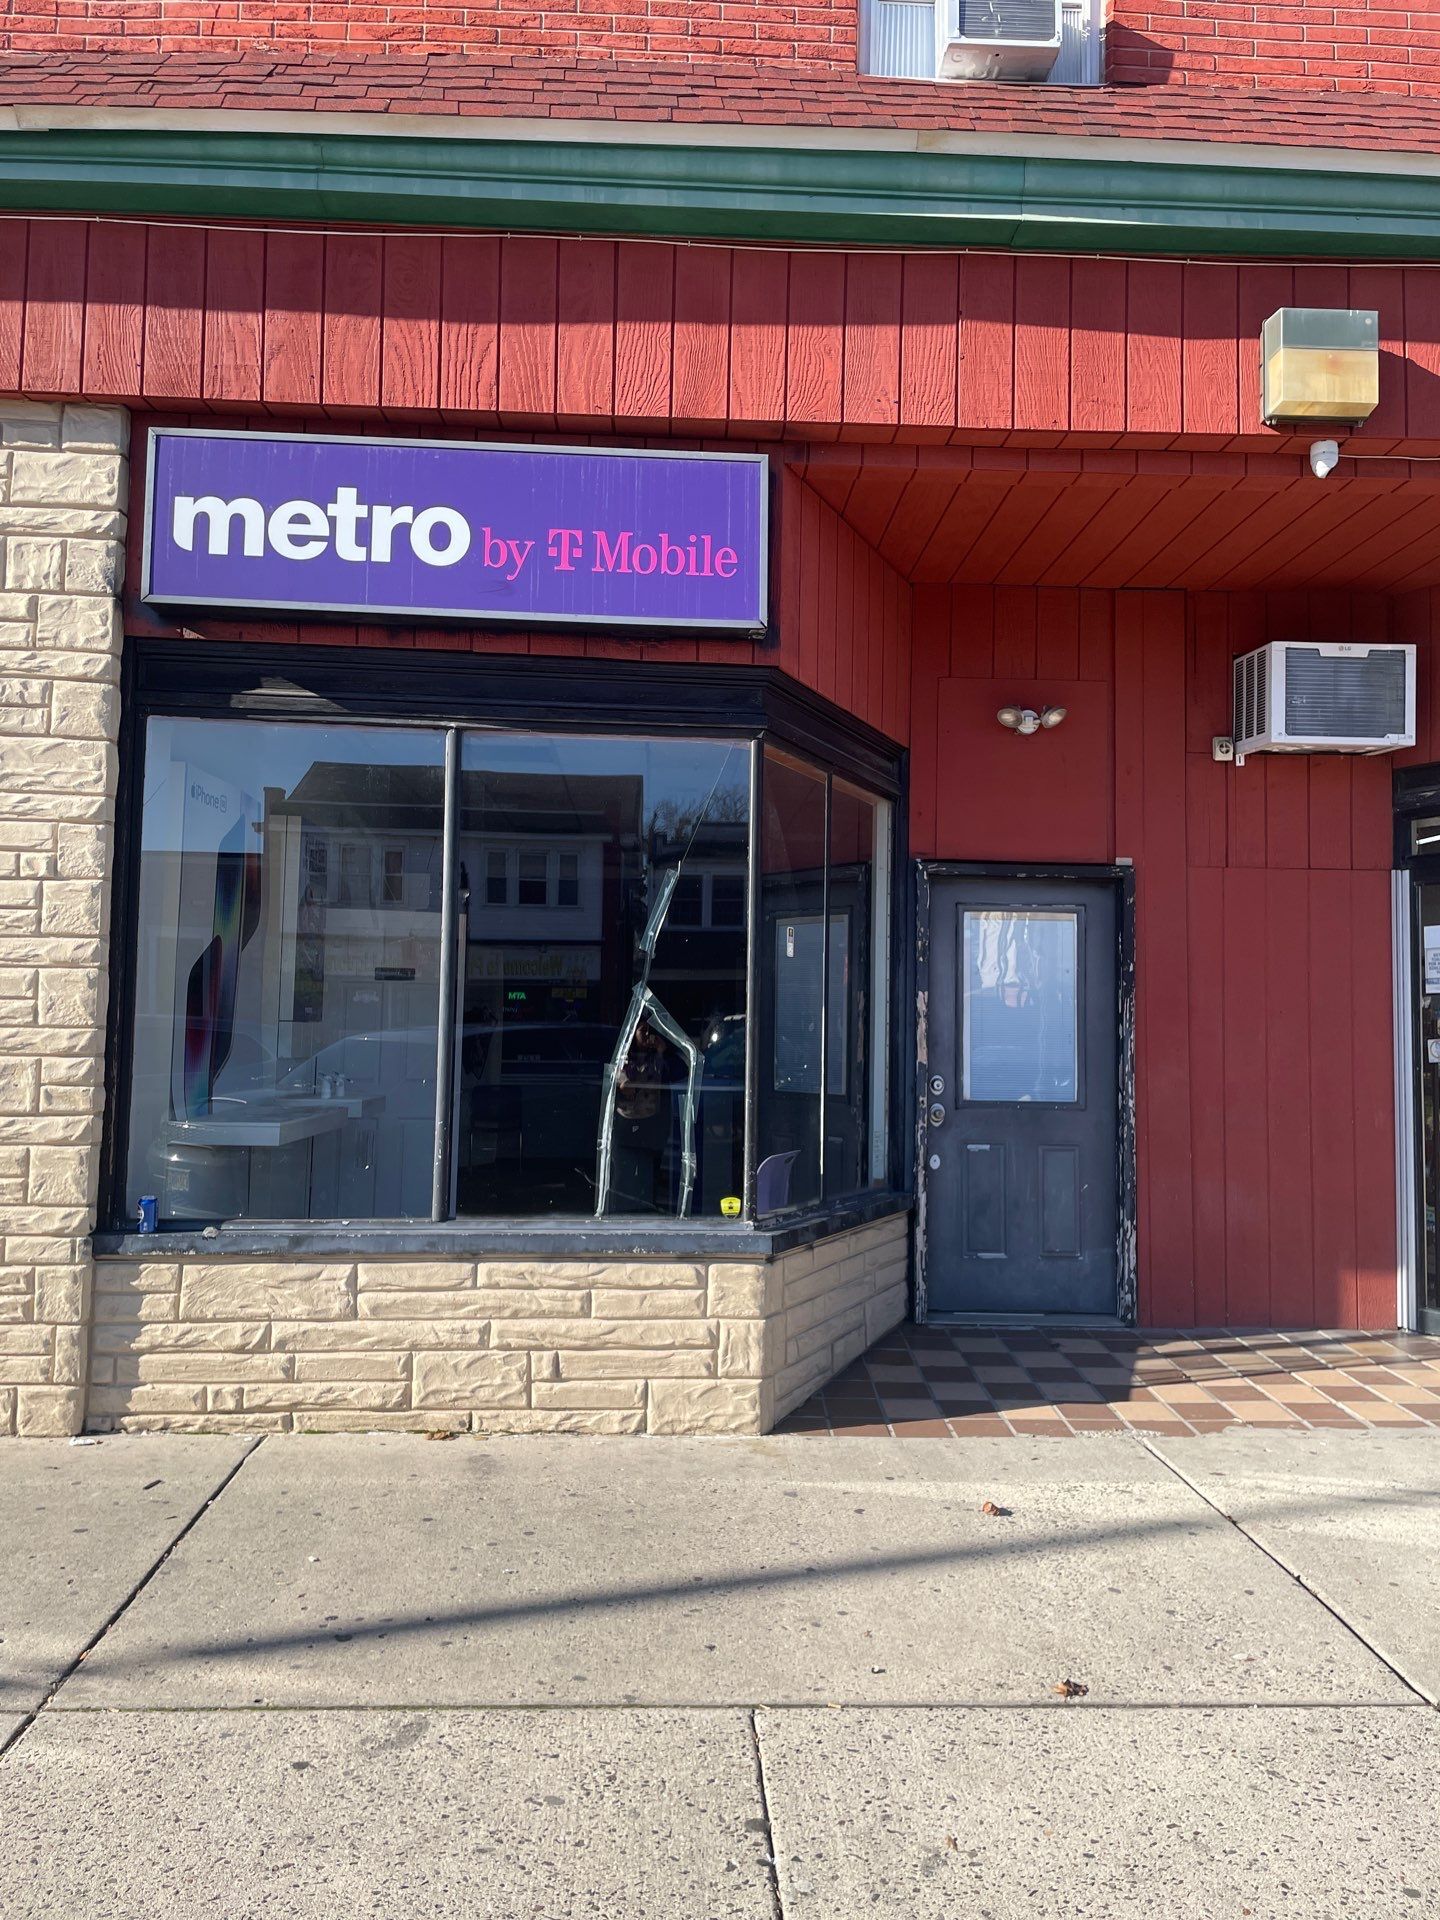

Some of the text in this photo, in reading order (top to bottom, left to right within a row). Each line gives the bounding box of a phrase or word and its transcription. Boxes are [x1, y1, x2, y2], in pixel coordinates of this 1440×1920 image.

[172, 487, 738, 581] metro by T Mobile
[195, 784, 220, 810] iPhone
